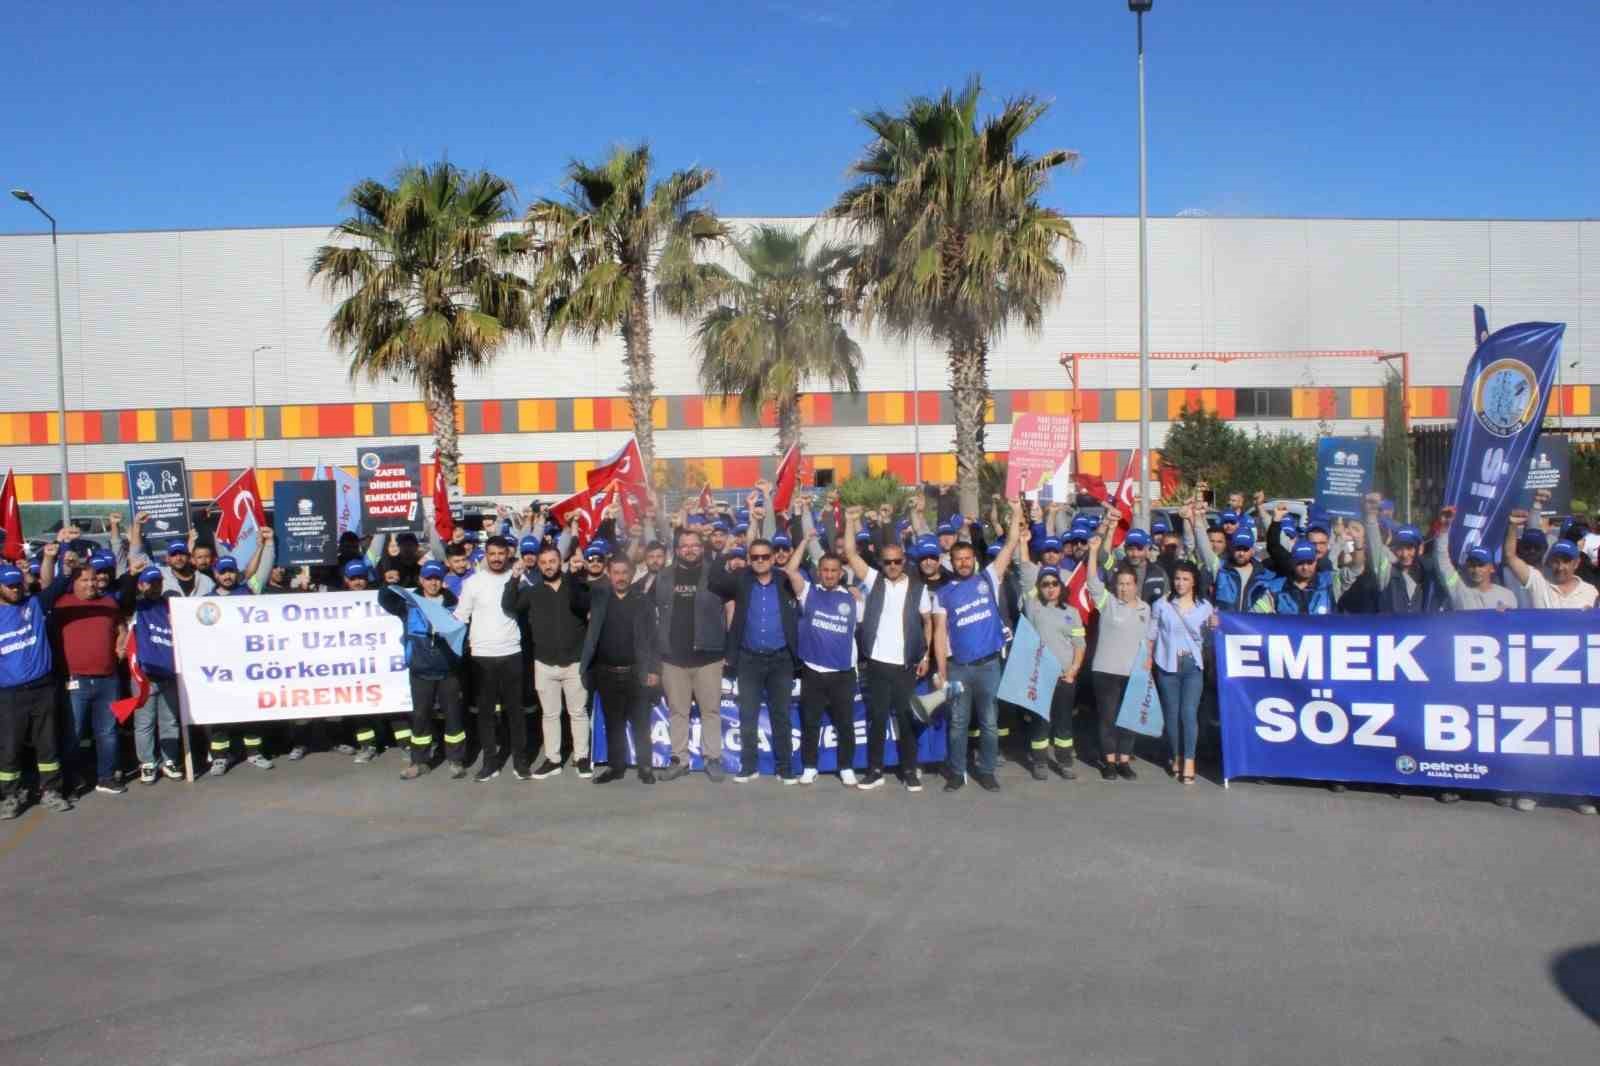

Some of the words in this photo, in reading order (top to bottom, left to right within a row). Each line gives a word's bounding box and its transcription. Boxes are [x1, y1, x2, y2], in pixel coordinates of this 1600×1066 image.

[374, 468, 405, 477] ZAFER
[370, 480, 411, 489] DİRENEN
[369, 504, 407, 514] OLACAK
[237, 606, 269, 624] Ya
[245, 634, 288, 652] Bir
[302, 630, 386, 652] Uzlaşı
[1224, 634, 1429, 682] EMEK
[200, 665, 233, 682] Ya
[246, 657, 377, 681] Görkemli
[257, 681, 384, 709] DİRENİŞ
[1255, 688, 1397, 748] SÖZ
[1419, 762, 1489, 775] petrol-iş
